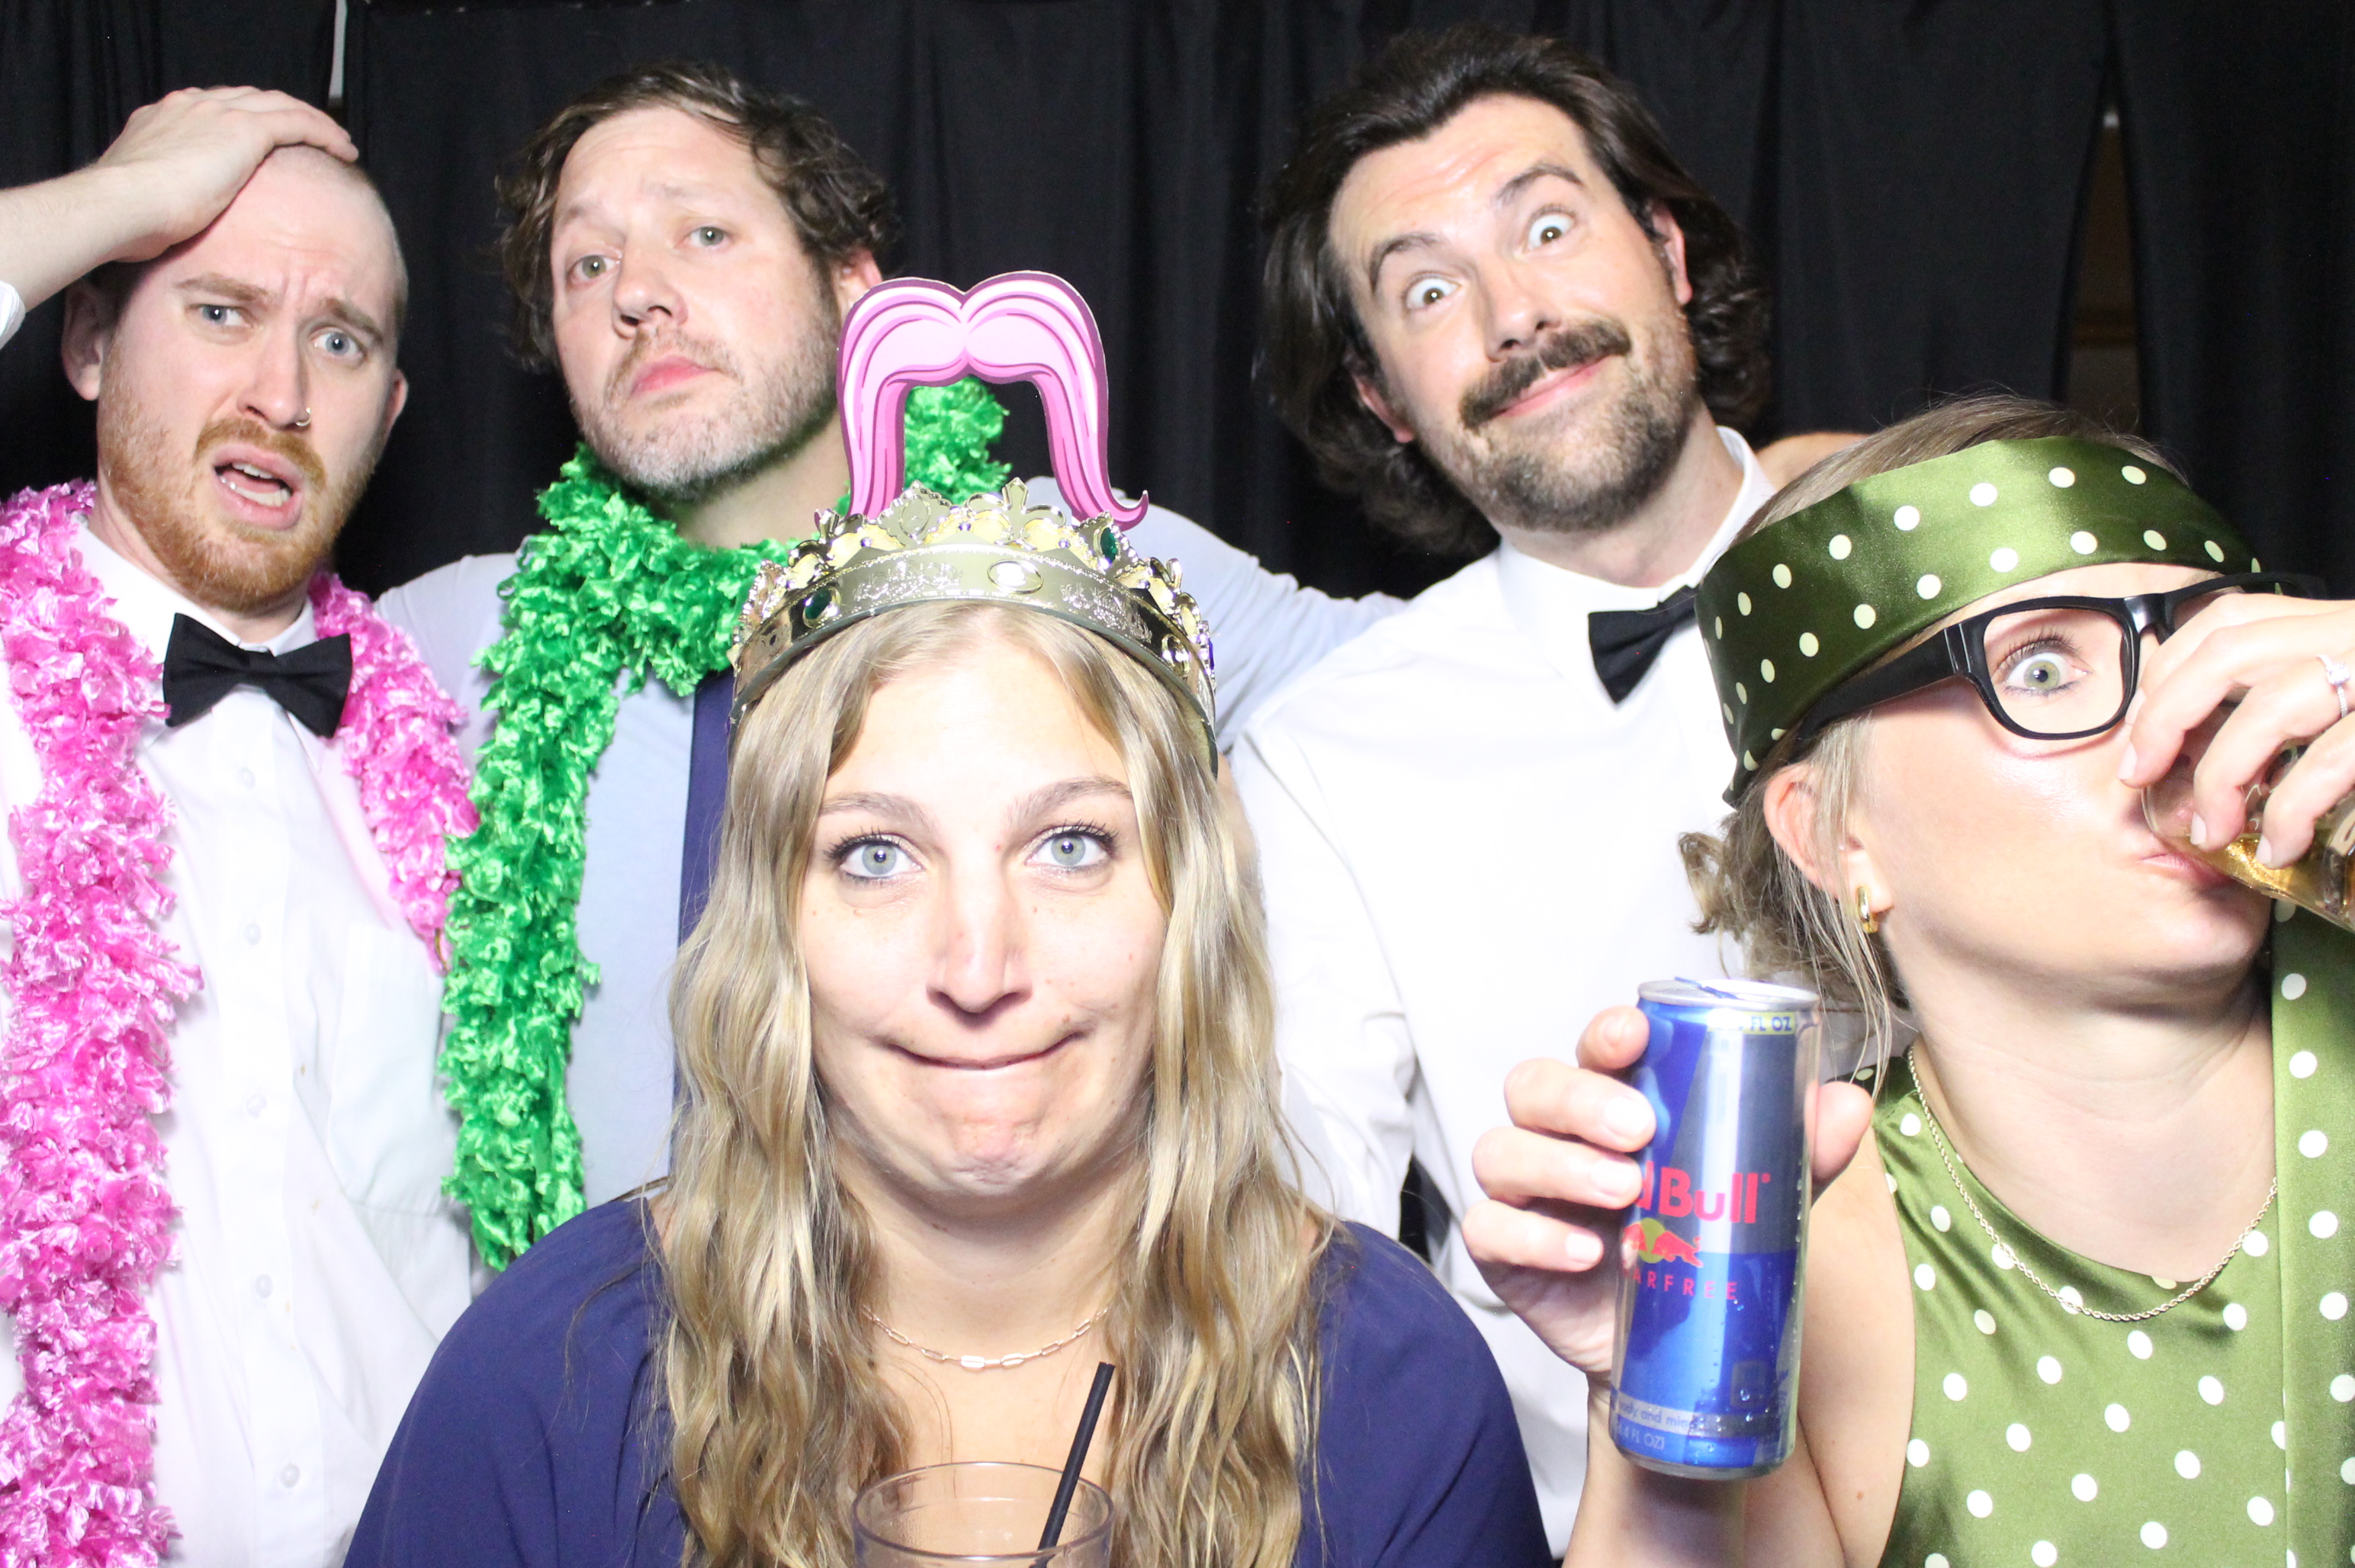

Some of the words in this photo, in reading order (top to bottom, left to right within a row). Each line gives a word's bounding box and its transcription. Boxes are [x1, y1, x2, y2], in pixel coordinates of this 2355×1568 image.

[1750, 1015, 1766, 1032] FL
[1772, 1016, 1792, 1032] OZ
[1658, 1166, 1759, 1224] Bull
[1623, 1266, 1738, 1301] ARFREE
[1640, 1409, 1663, 1424] and
